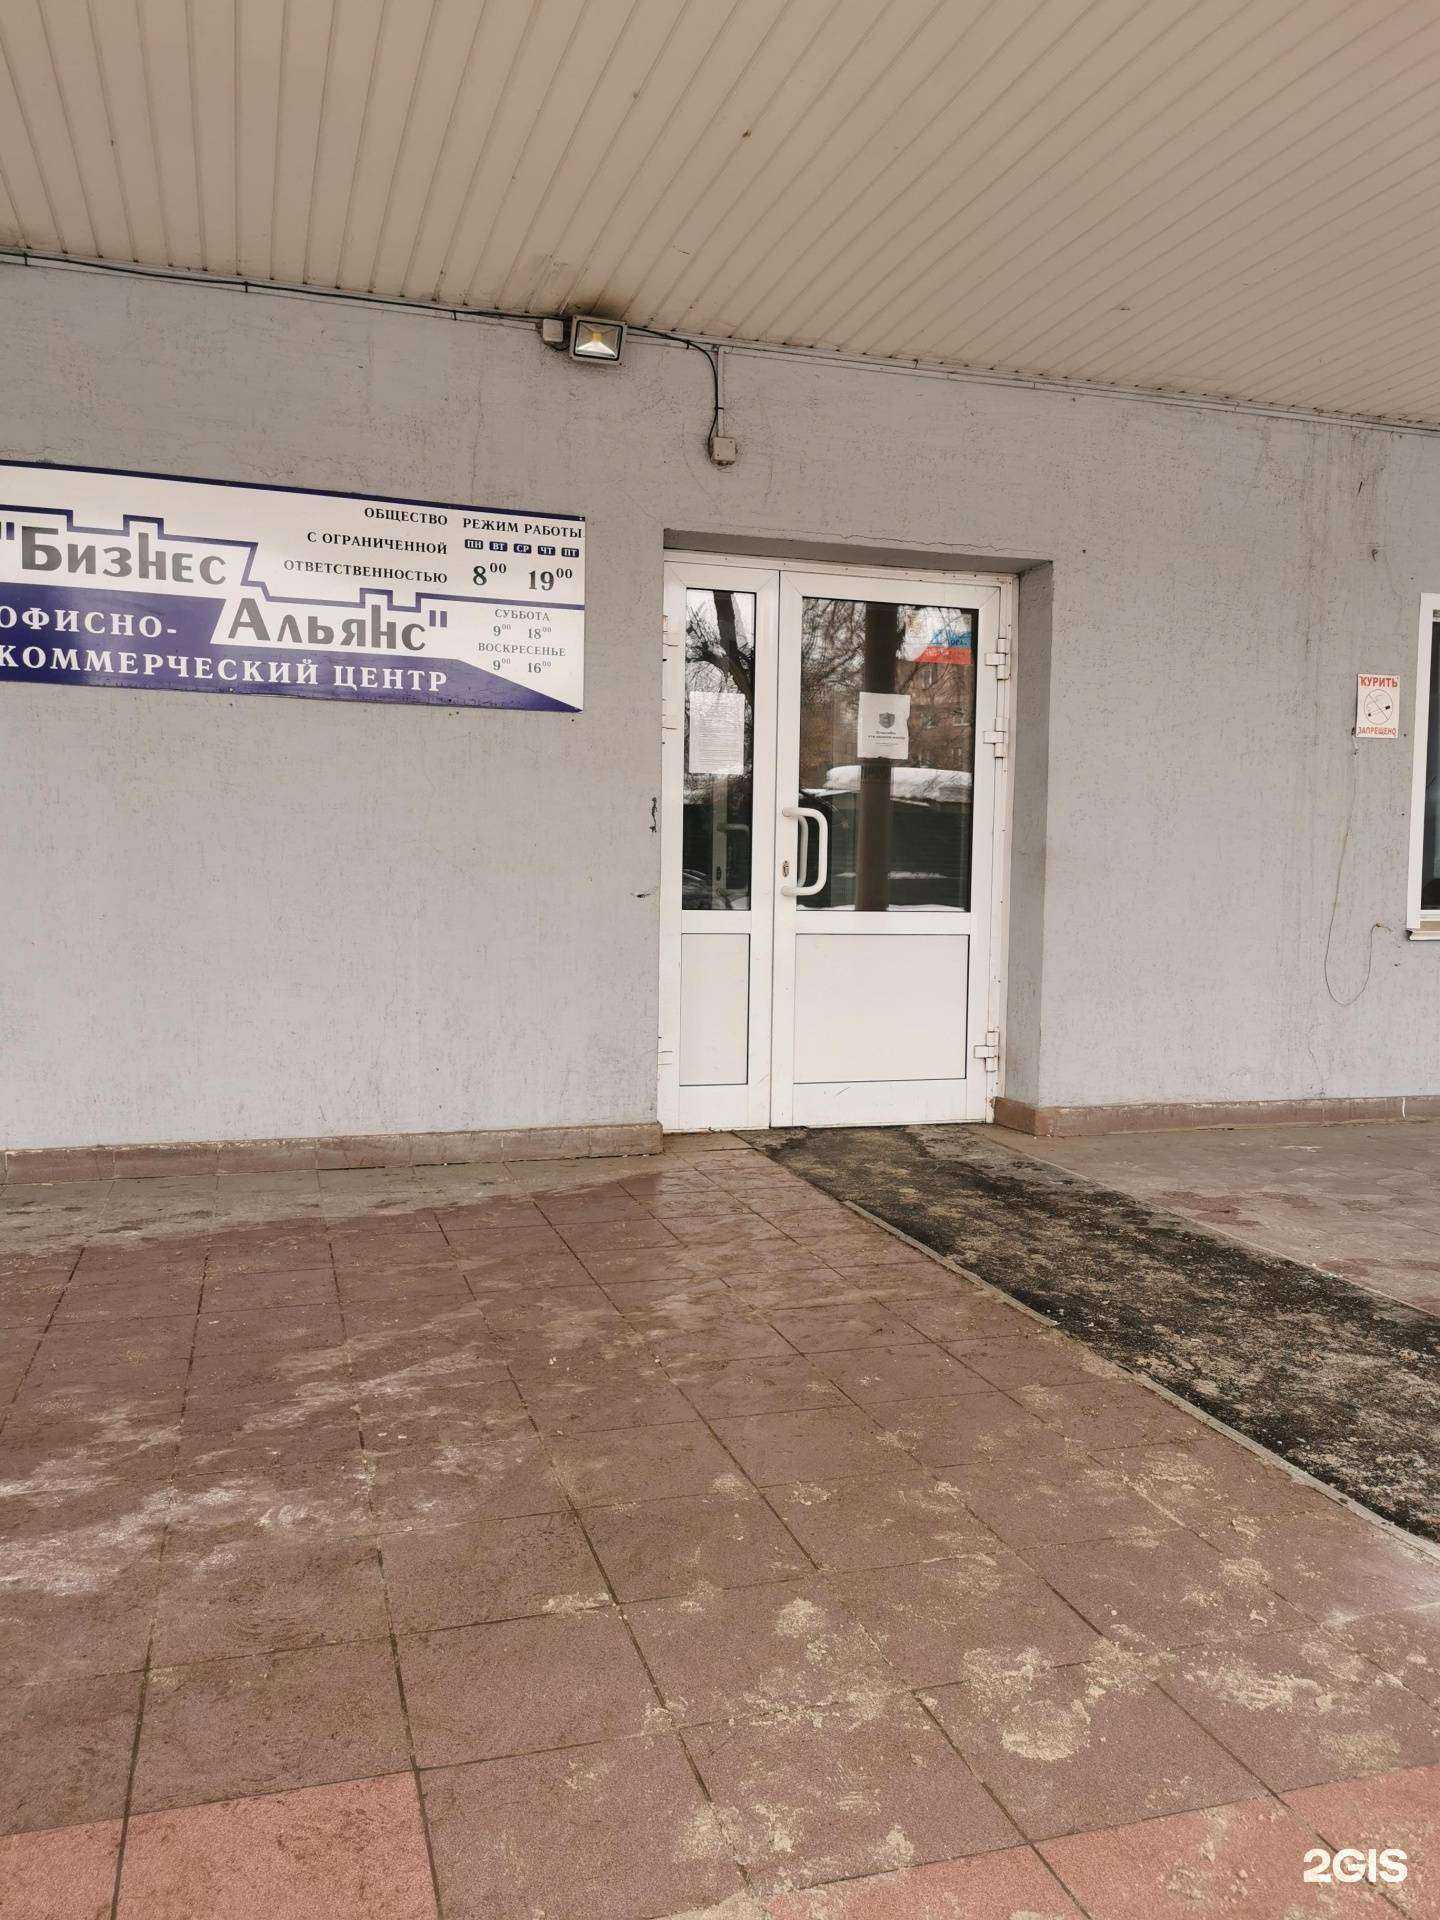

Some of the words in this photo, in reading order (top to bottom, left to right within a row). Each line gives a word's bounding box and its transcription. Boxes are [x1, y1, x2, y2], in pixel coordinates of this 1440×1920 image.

[364, 507, 448, 526] ОБЩЕСТВО
[463, 517, 519, 534] РЕЖИМ
[524, 523, 583, 539] РАБОТЫ
[307, 531, 317, 543] С
[322, 532, 448, 555] ОГРАНИЧЕННОЙ
[466, 540, 482, 550] ПН
[516, 544, 531, 554] СР
[539, 546, 555, 556] ЧТ
[564, 548, 578, 558] ПТ
[283, 559, 448, 584] ОТВЕТСТВЕННОСТЬЮ
[0, 605, 177, 638] ОФИСНО-
[494, 608, 550, 622] СУББОТА
[478, 642, 566, 657] ВОСКРЕСЕНЬЕ
[0, 644, 319, 685] КОММЕРЧЕСКИЙ
[334, 665, 448, 692] ЦЕНТР
[1360, 676, 1398, 688] КУРИТЬ
